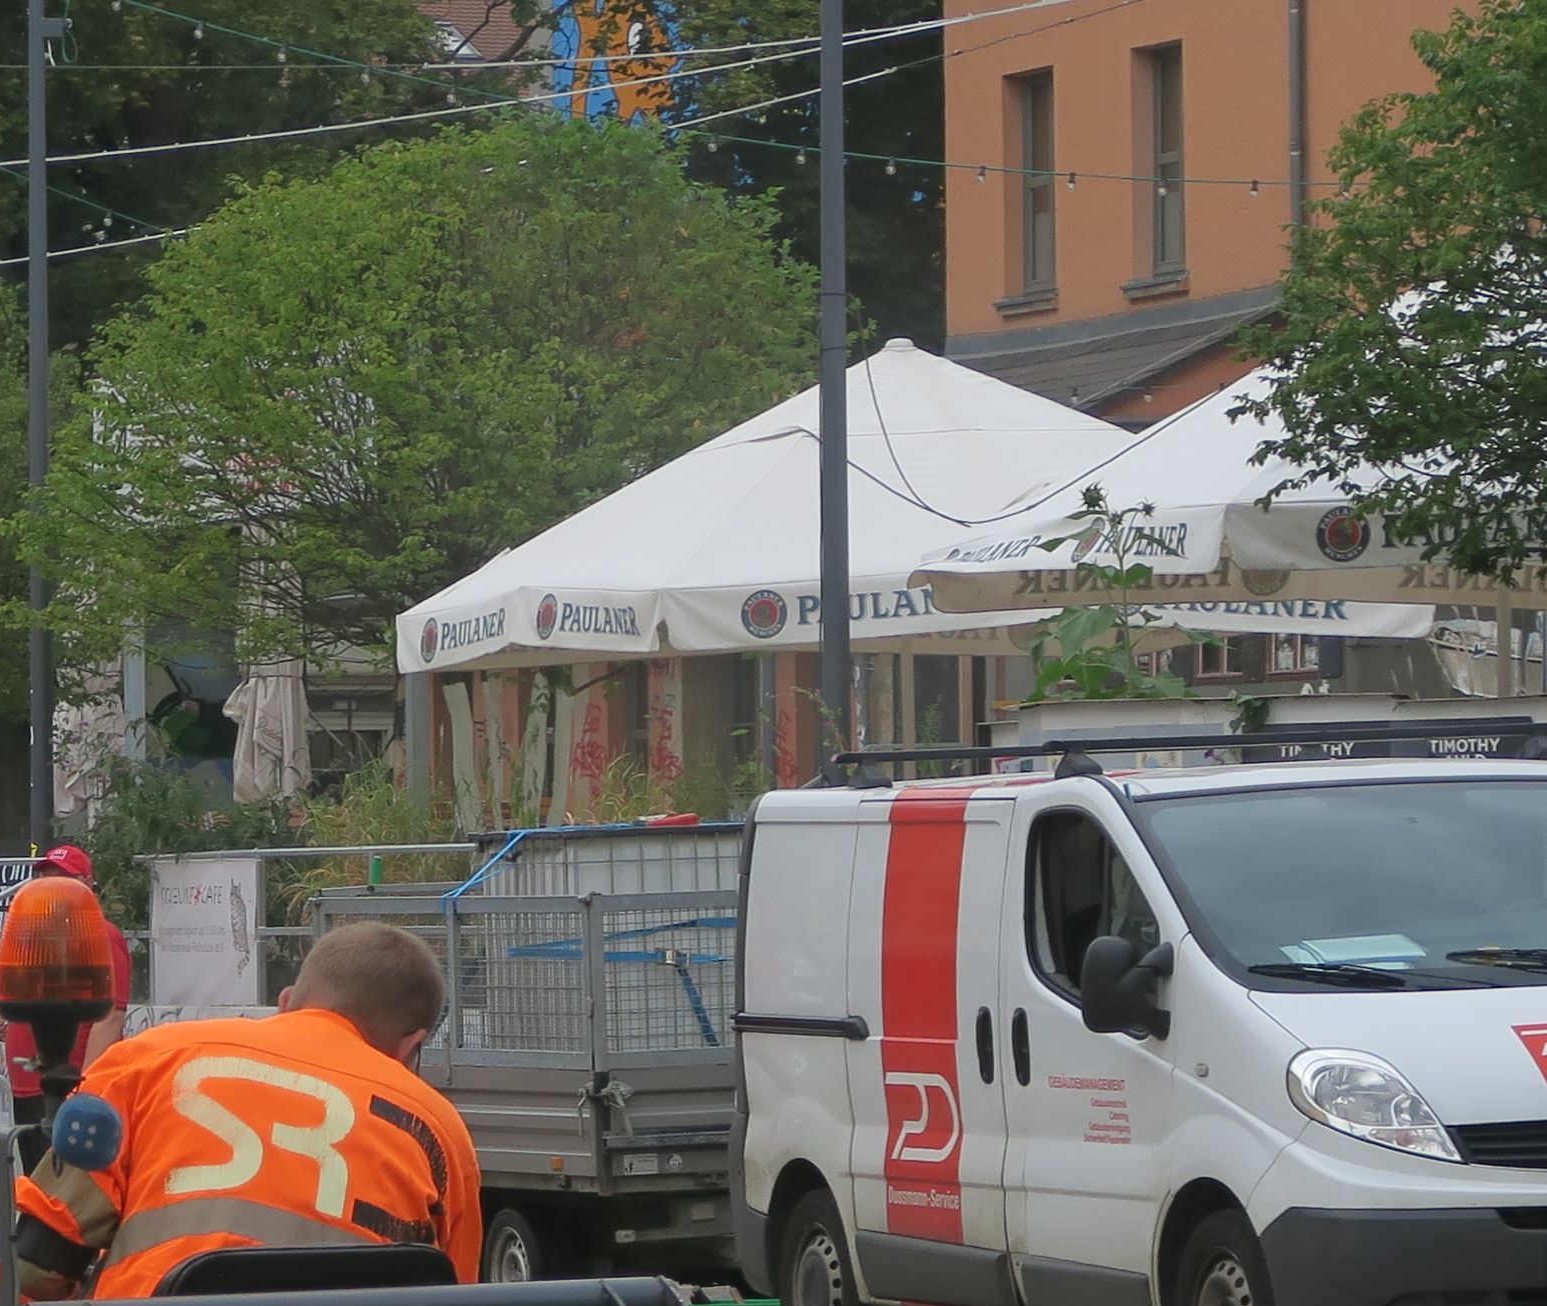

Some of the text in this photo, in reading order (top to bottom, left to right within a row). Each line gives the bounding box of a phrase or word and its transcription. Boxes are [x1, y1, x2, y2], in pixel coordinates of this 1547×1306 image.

[440, 607, 505, 650] PAULANER
[559, 603, 641, 636] PAULANER
[1430, 737, 1501, 753] TIMOTHY
[164, 1056, 356, 1219] SR
[888, 1186, 960, 1211] Dussmann-Service
